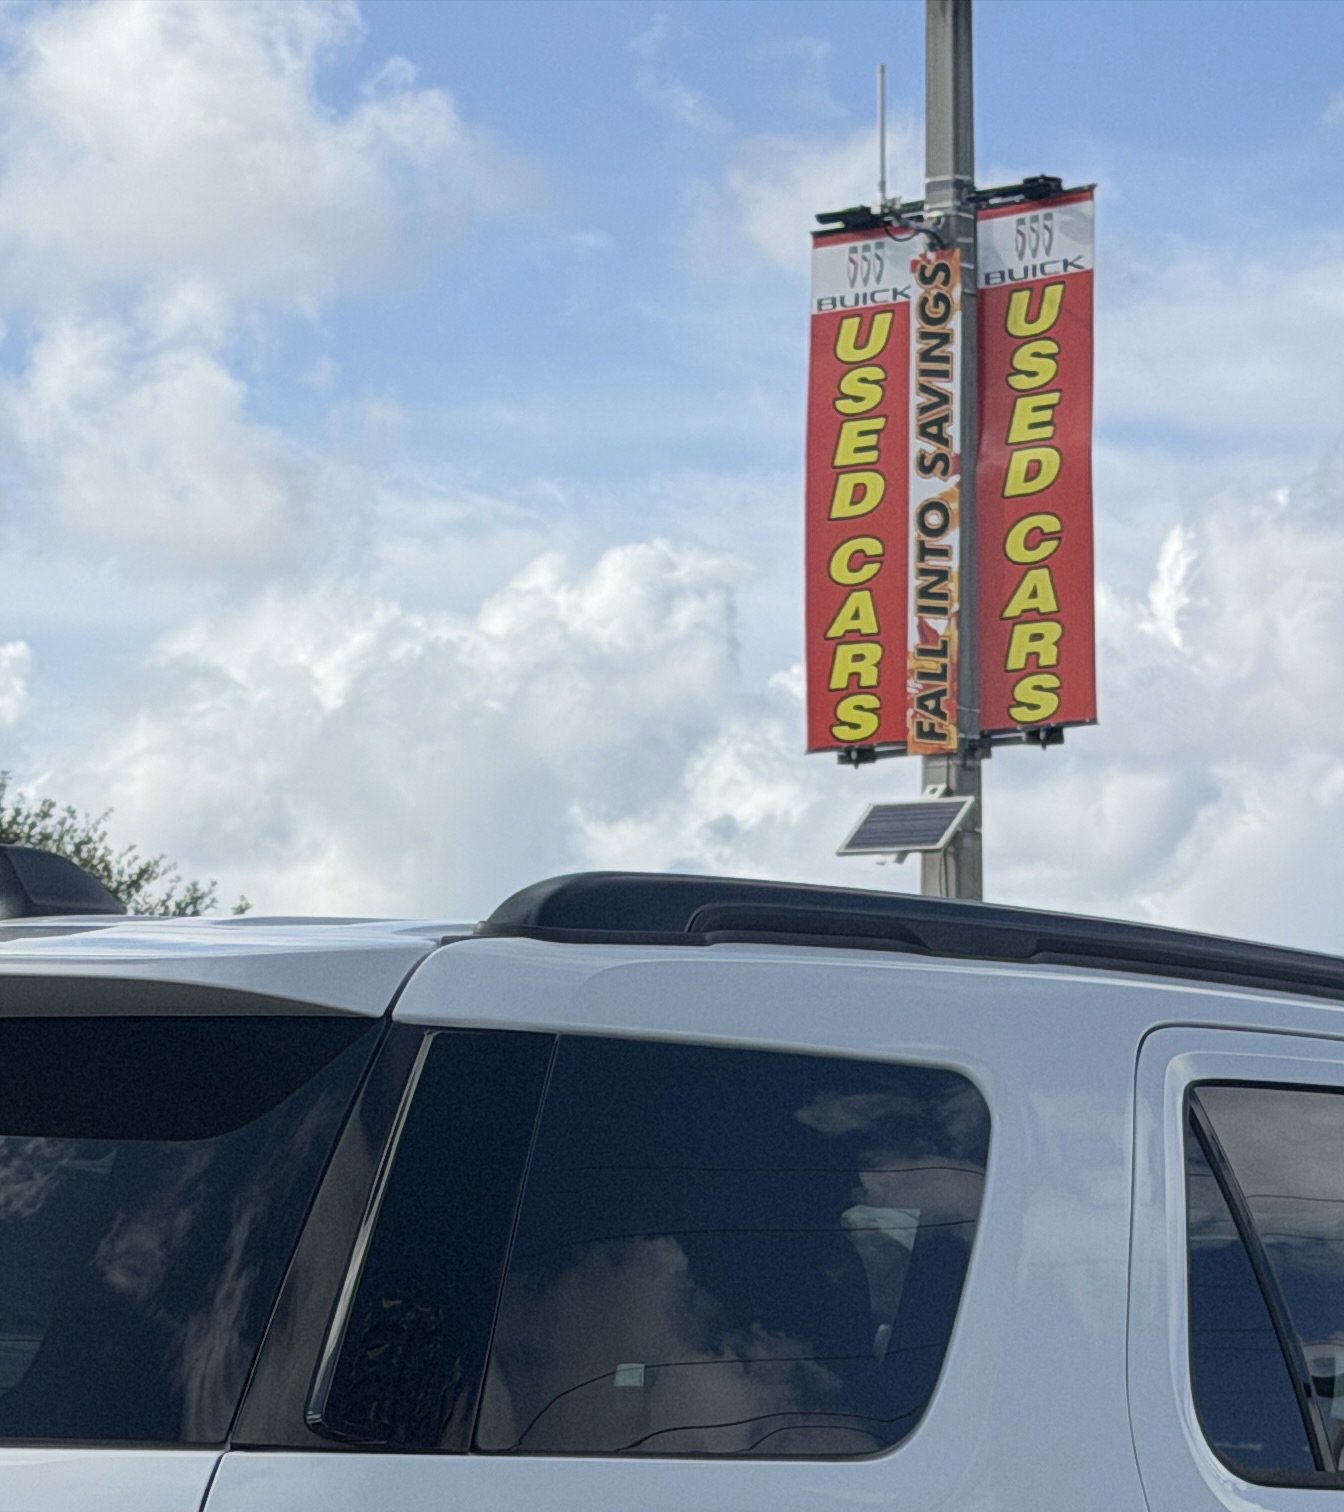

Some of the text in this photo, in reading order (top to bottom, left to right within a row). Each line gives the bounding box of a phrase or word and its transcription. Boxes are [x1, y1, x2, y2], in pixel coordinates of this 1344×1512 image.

[816, 284, 911, 312] BUICK
[985, 255, 1086, 286] BUICK
[824, 309, 894, 743] USED CARS
[914, 259, 955, 744] FALL INTO SAVINGS
[1000, 281, 1066, 724] USED CARS
